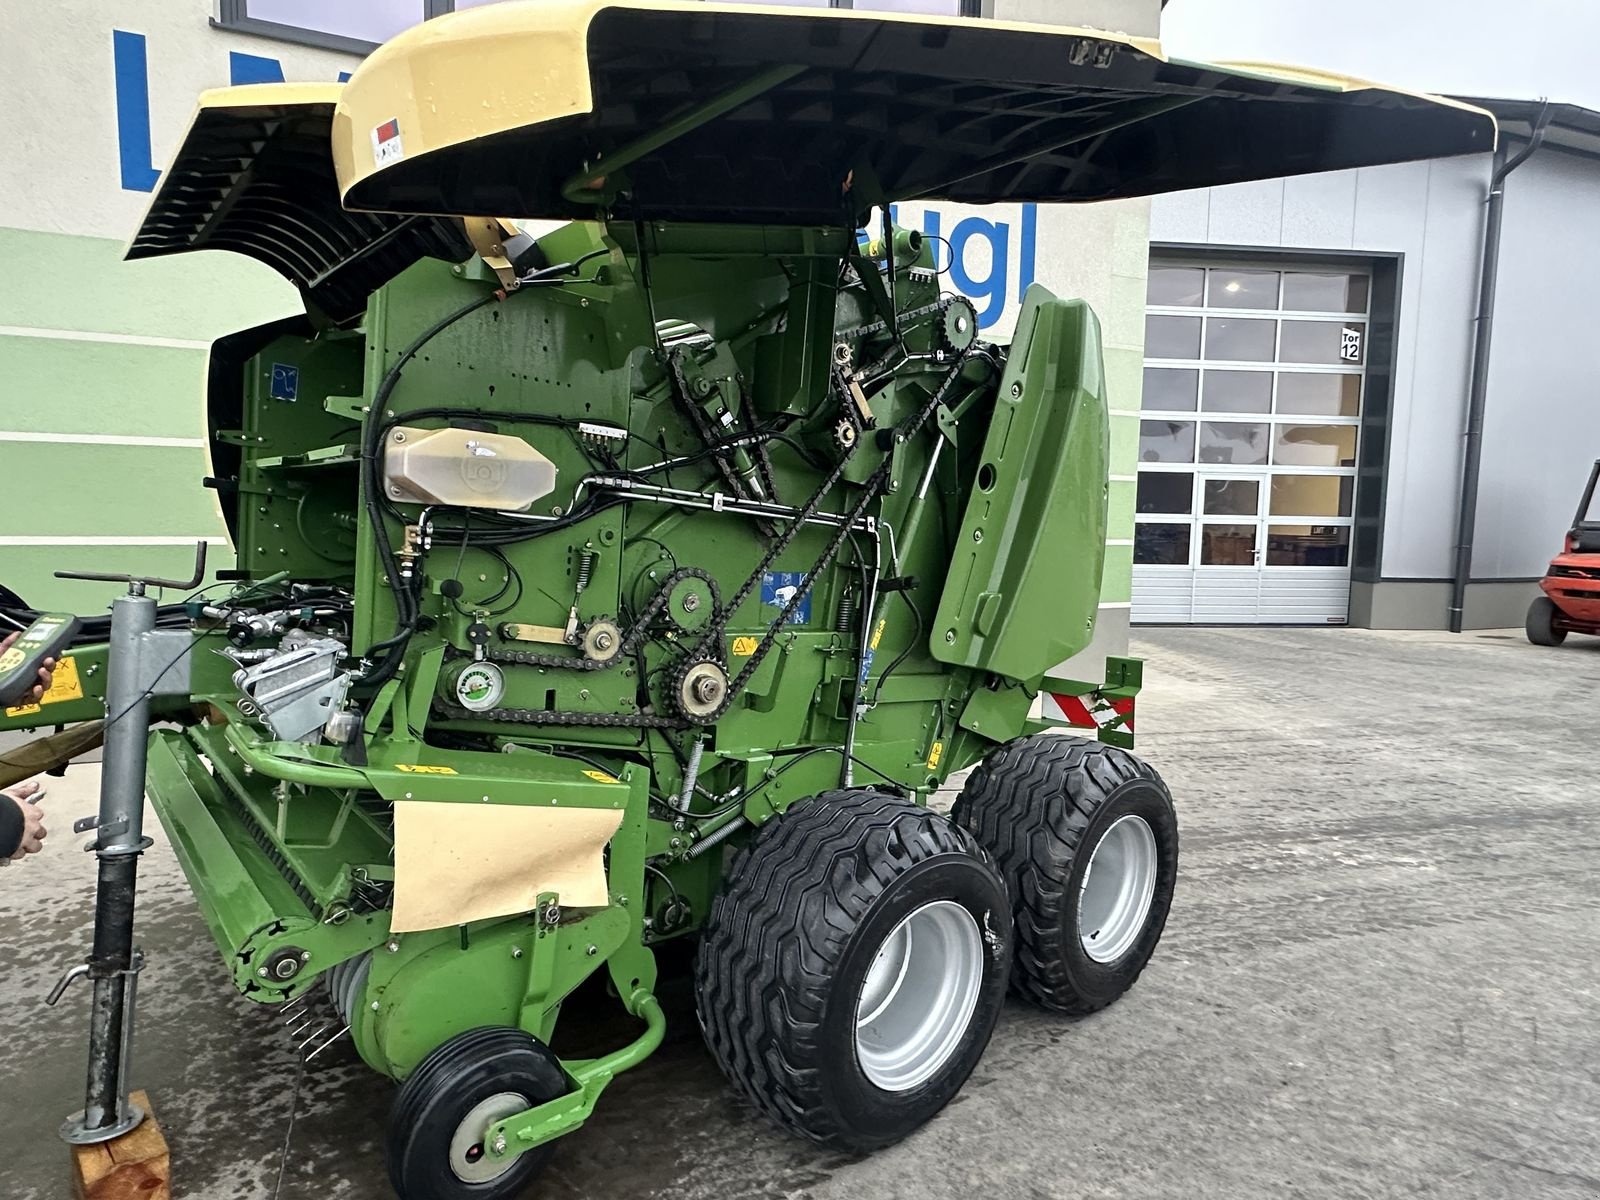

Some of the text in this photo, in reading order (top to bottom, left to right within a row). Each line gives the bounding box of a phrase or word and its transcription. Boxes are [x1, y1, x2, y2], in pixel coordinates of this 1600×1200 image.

[857, 203, 1037, 330] ugl
[1343, 333, 1359, 343] Tor
[1342, 344, 1359, 358] 12
